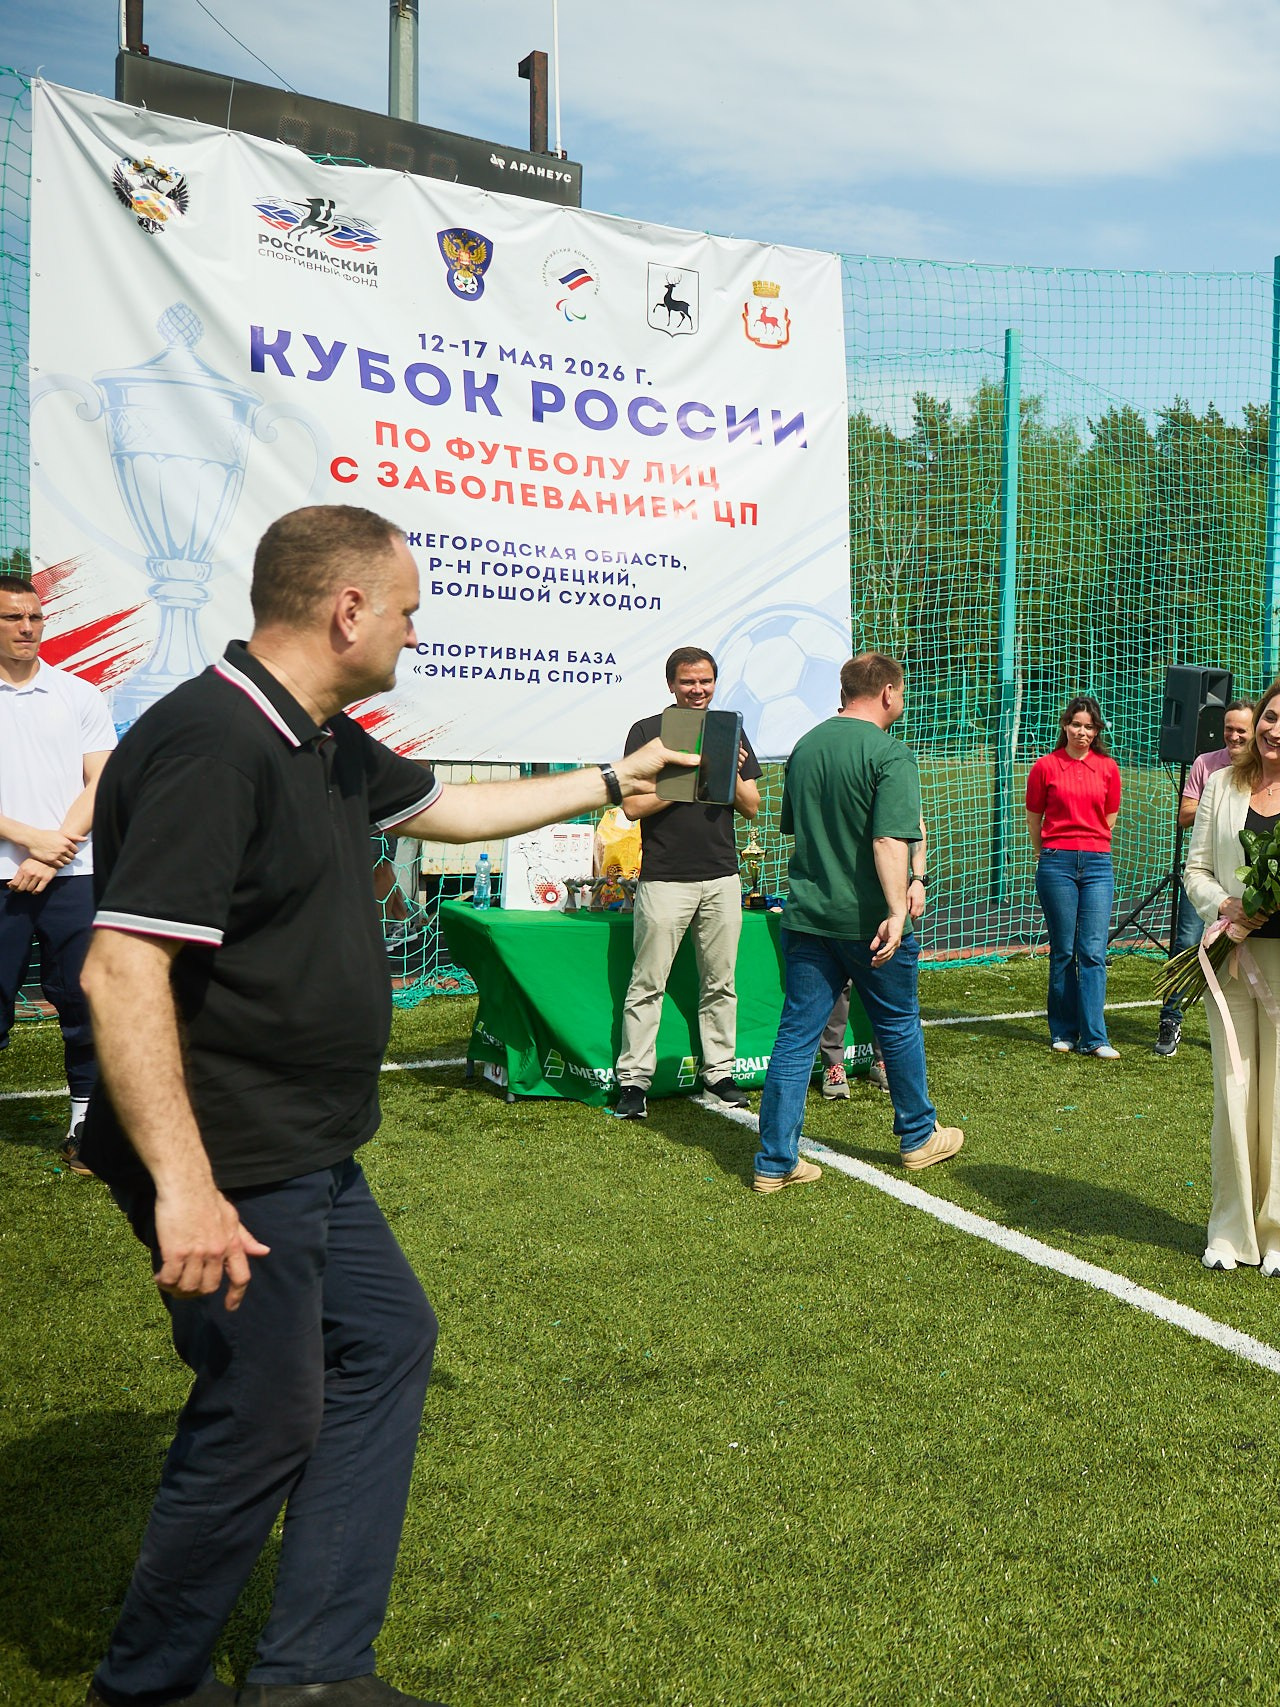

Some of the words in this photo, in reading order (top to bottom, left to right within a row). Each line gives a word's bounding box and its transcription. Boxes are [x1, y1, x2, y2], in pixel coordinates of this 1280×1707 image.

[509, 160, 572, 183] АРАНЕУС
[258, 233, 378, 276] РОССИЙСКИЙ
[258, 248, 341, 276] СПОРТИВНЫЙ
[343, 274, 378, 288] ФОНД
[418, 333, 488, 359] 12-17
[499, 345, 553, 371] МАЯ
[564, 357, 625, 382] 2026
[636, 368, 653, 386] Г.
[250, 325, 503, 417] КУБОК
[531, 379, 808, 449] РОССИИ
[375, 420, 431, 453] ПО
[445, 436, 630, 480] ФУТБОЛУ
[643, 461, 720, 492] ЛИЦ
[330, 456, 359, 484] С
[376, 460, 699, 521] ЗАБОЛЕВАНИЕМ
[713, 500, 758, 529] ЦП
[405, 531, 577, 561] ЖЕГОРОДСКАЯ
[585, 549, 688, 571] ОБЛАСТЬ,
[429, 557, 471, 574] Р-Н
[481, 561, 637, 589] ГОРОДЕЦКИЙ,
[431, 580, 551, 604] БОЛЬШОЙ
[559, 590, 661, 611] СУХОДОЛ
[415, 642, 559, 663] СПОРТИВНАЯ
[567, 650, 617, 665] БАЗА
[413, 664, 541, 684] «ЭМЕРАЛЬД
[547, 670, 623, 685] СПОРТ»
[844, 1043, 875, 1060] MERA
[850, 1057, 873, 1066] SPORT
[568, 1062, 617, 1083] EMERA
[589, 1080, 615, 1091] SPORT
